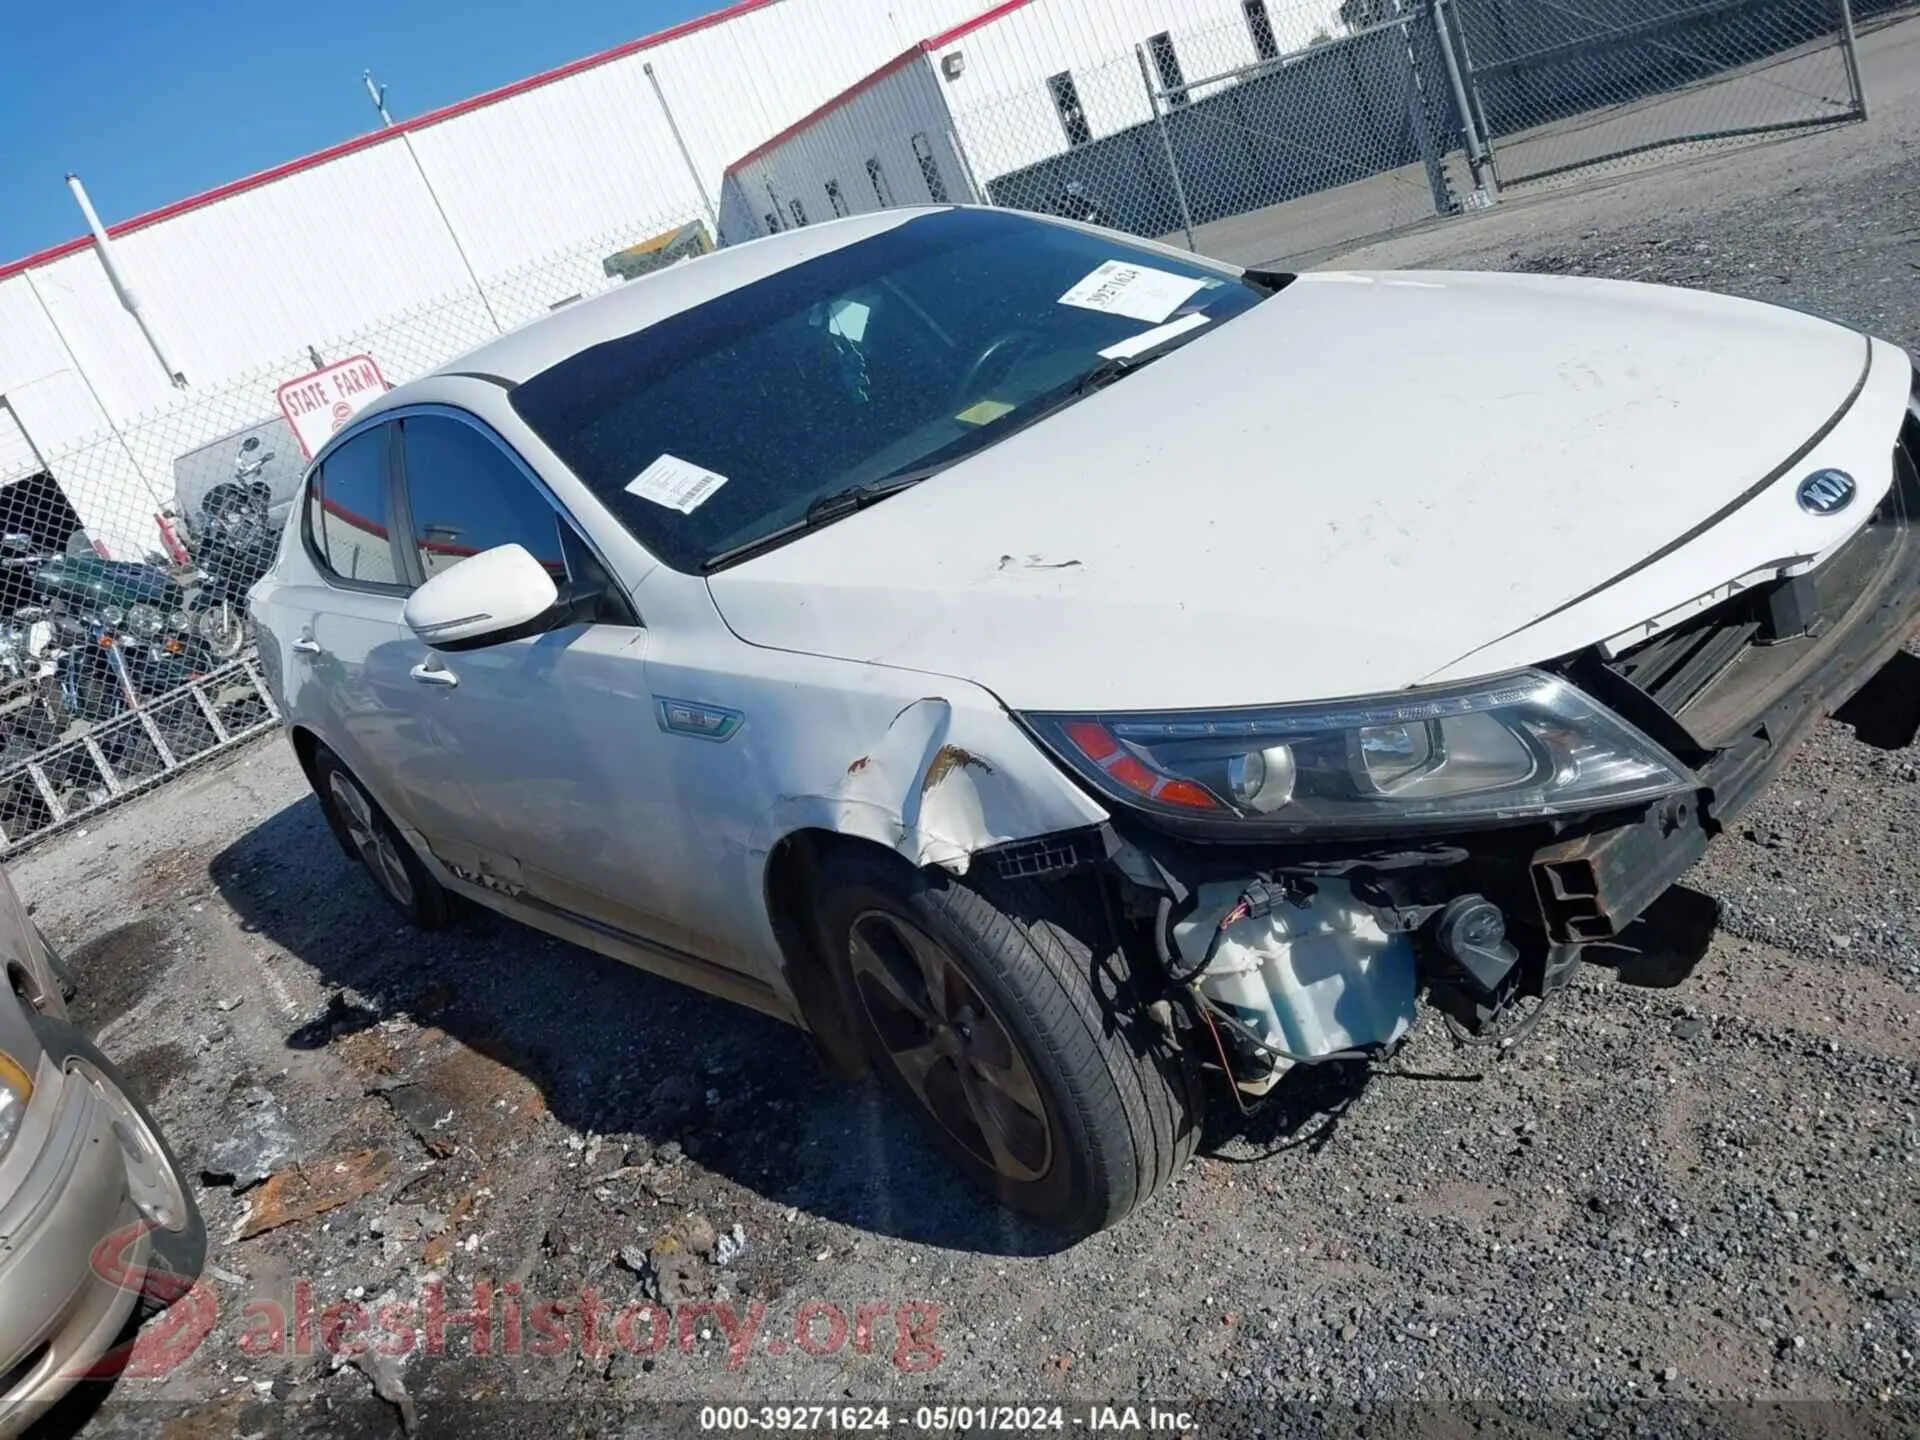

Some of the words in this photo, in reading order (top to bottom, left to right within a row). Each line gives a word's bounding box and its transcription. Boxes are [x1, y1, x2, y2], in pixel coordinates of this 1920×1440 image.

[285, 382, 330, 417] STATE
[332, 363, 378, 398] FARM
[1803, 471, 1853, 509] KIA
